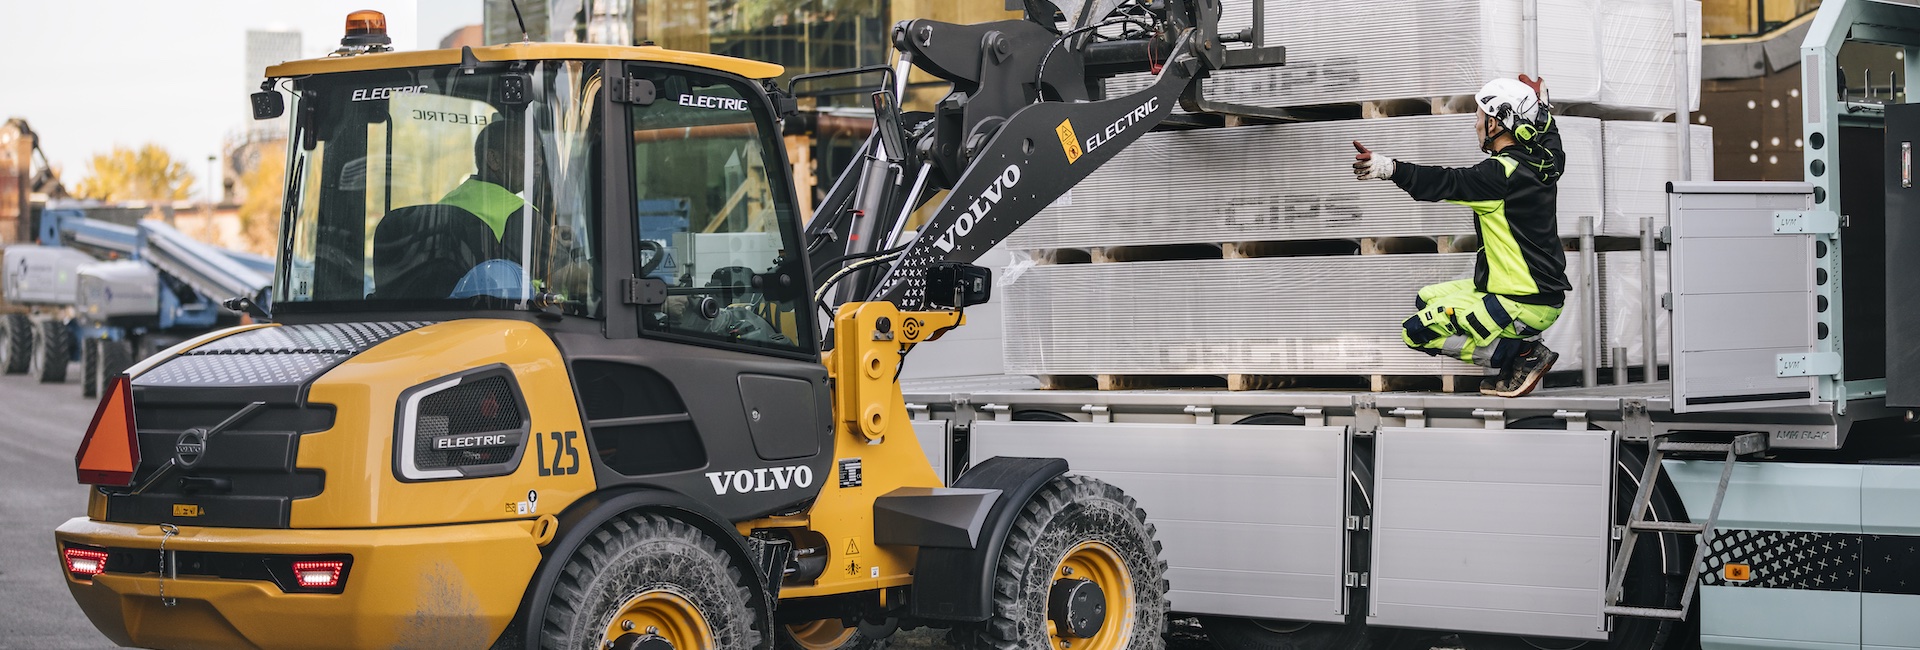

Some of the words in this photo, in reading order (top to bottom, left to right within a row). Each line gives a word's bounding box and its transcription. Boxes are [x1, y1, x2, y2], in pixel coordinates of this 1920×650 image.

[351, 85, 428, 102] ELECTRIC
[679, 94, 748, 111] ELECTRIC
[1086, 96, 1159, 153] ELECTRIC
[932, 164, 1021, 254] VOLVO
[1781, 218, 1797, 227] LVM
[1784, 361, 1800, 370] LVM
[438, 434, 506, 449] ELECTRIC
[1776, 430, 1799, 440] LVM
[1801, 431, 1830, 441] FLAK
[176, 445, 202, 453] VOLVO
[536, 431, 580, 477] L25
[705, 465, 813, 496] VOLVO
